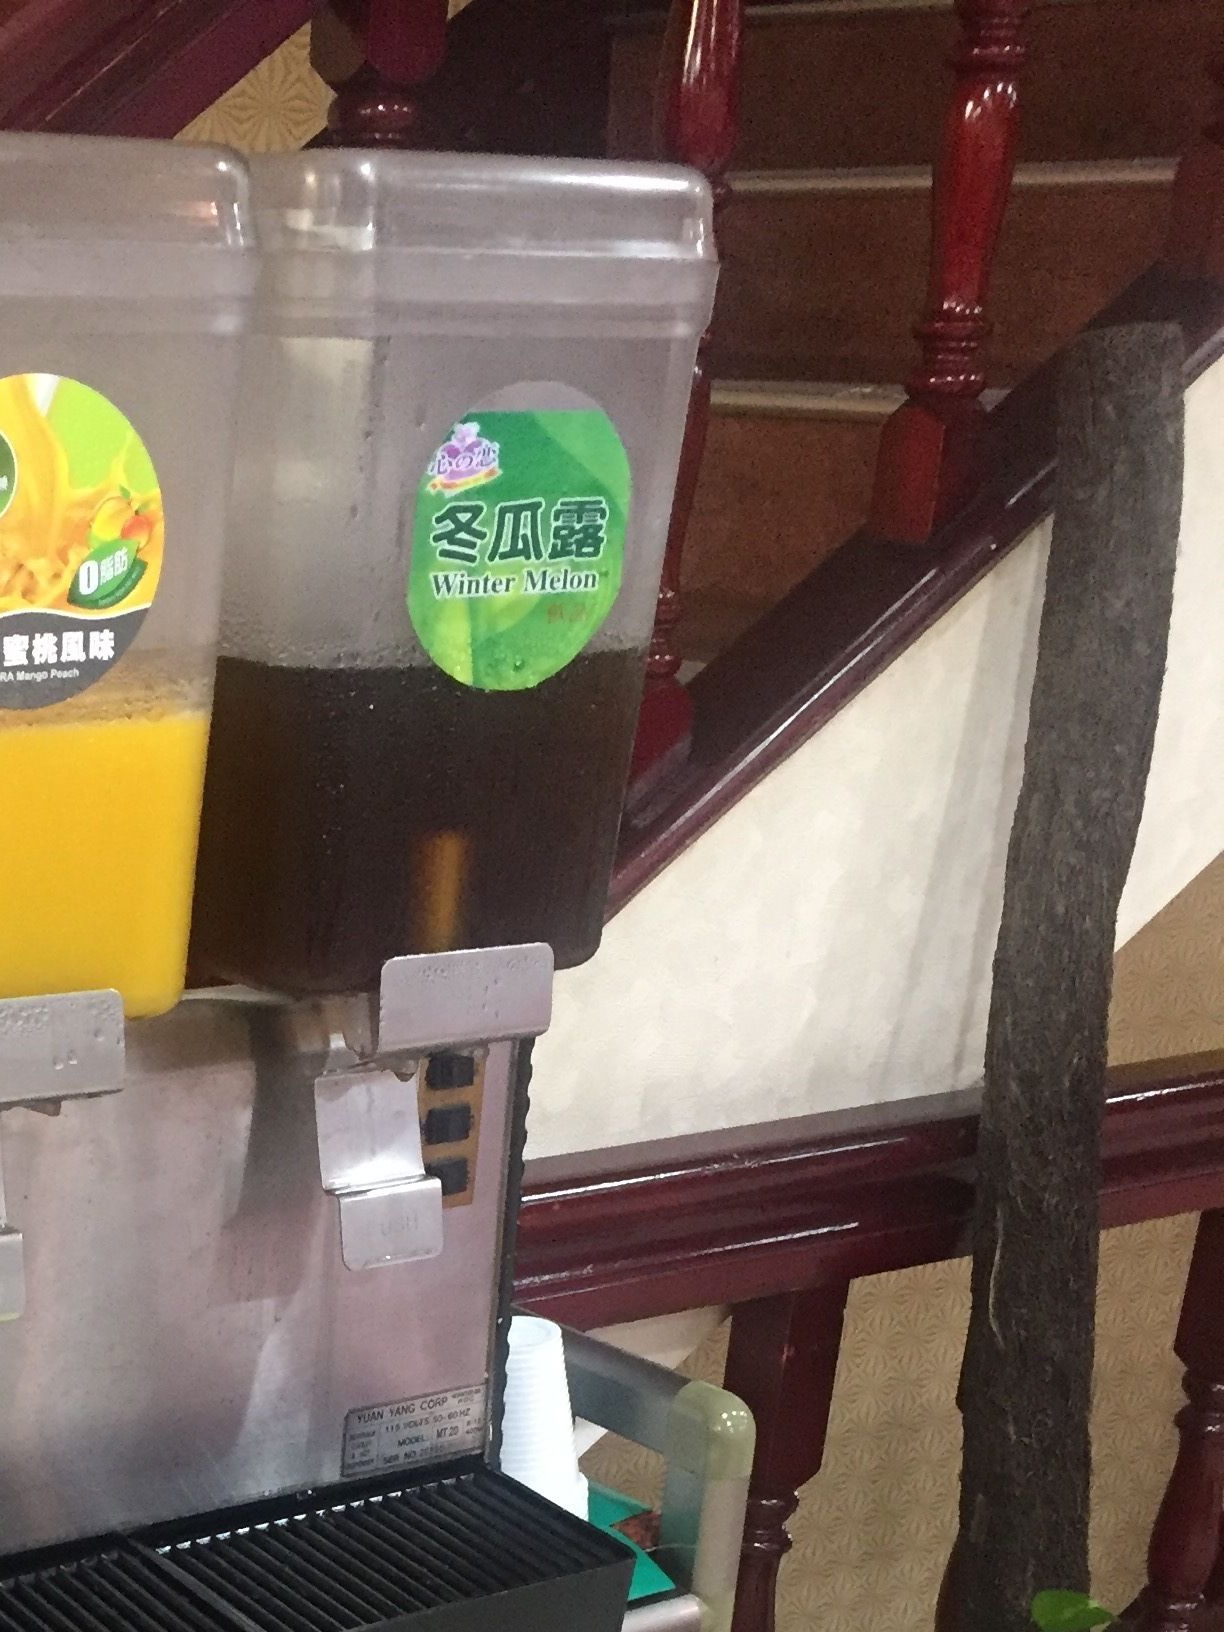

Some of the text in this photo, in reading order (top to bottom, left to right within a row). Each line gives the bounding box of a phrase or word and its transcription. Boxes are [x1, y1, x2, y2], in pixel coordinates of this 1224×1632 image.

[432, 498, 608, 564] 冬瓜露
[432, 569, 598, 597] Winter Melon
[16, 667, 48, 683] Mango
[50, 666, 80, 680] Peach
[357, 1409, 384, 1424] YUAN
[389, 1403, 416, 1418] YANG
[419, 1396, 449, 1411] CORP
[397, 1433, 426, 1448] MODEL
